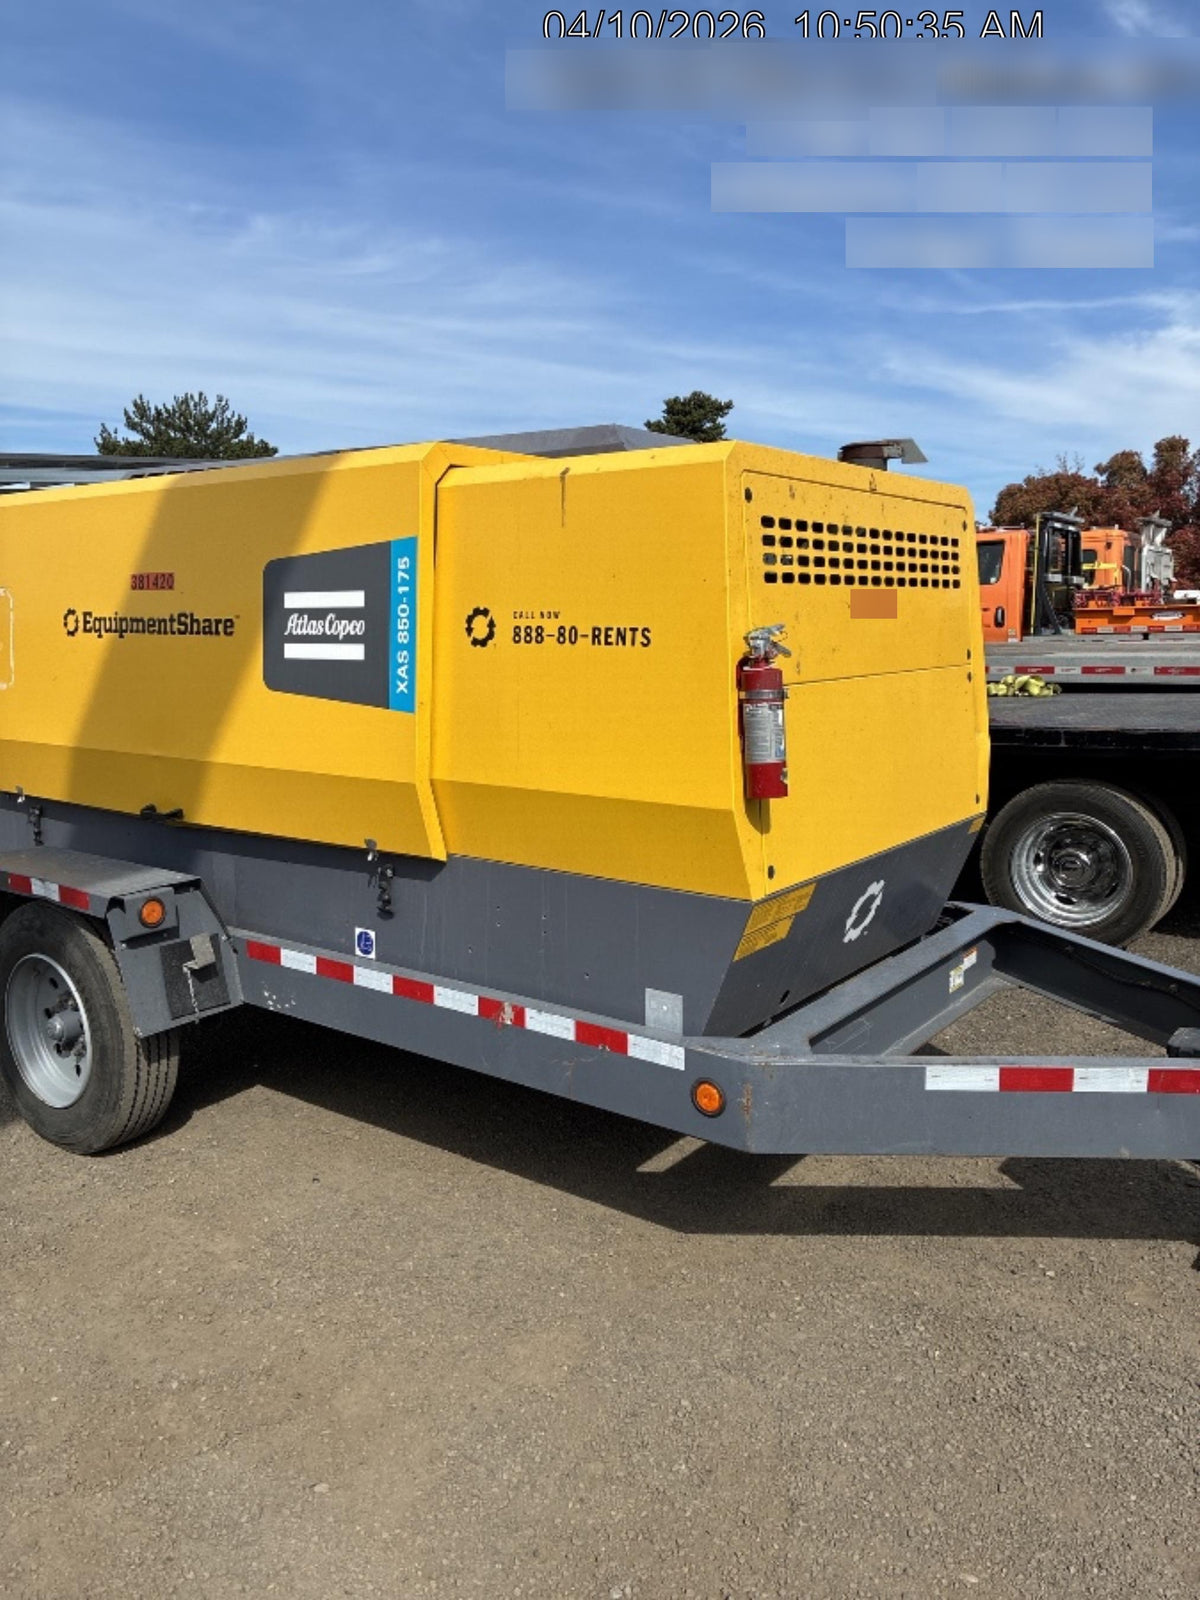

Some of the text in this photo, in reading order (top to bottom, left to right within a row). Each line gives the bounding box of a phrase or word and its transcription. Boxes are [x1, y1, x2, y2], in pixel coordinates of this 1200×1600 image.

[131, 573, 175, 590] 381420
[82, 611, 235, 638] EquipmentShare
[284, 612, 365, 641] Atlas Copco
[396, 556, 410, 694] XAS 850-175
[513, 611, 561, 620] CALL NOW
[512, 625, 652, 648] 888-80-RENTS
